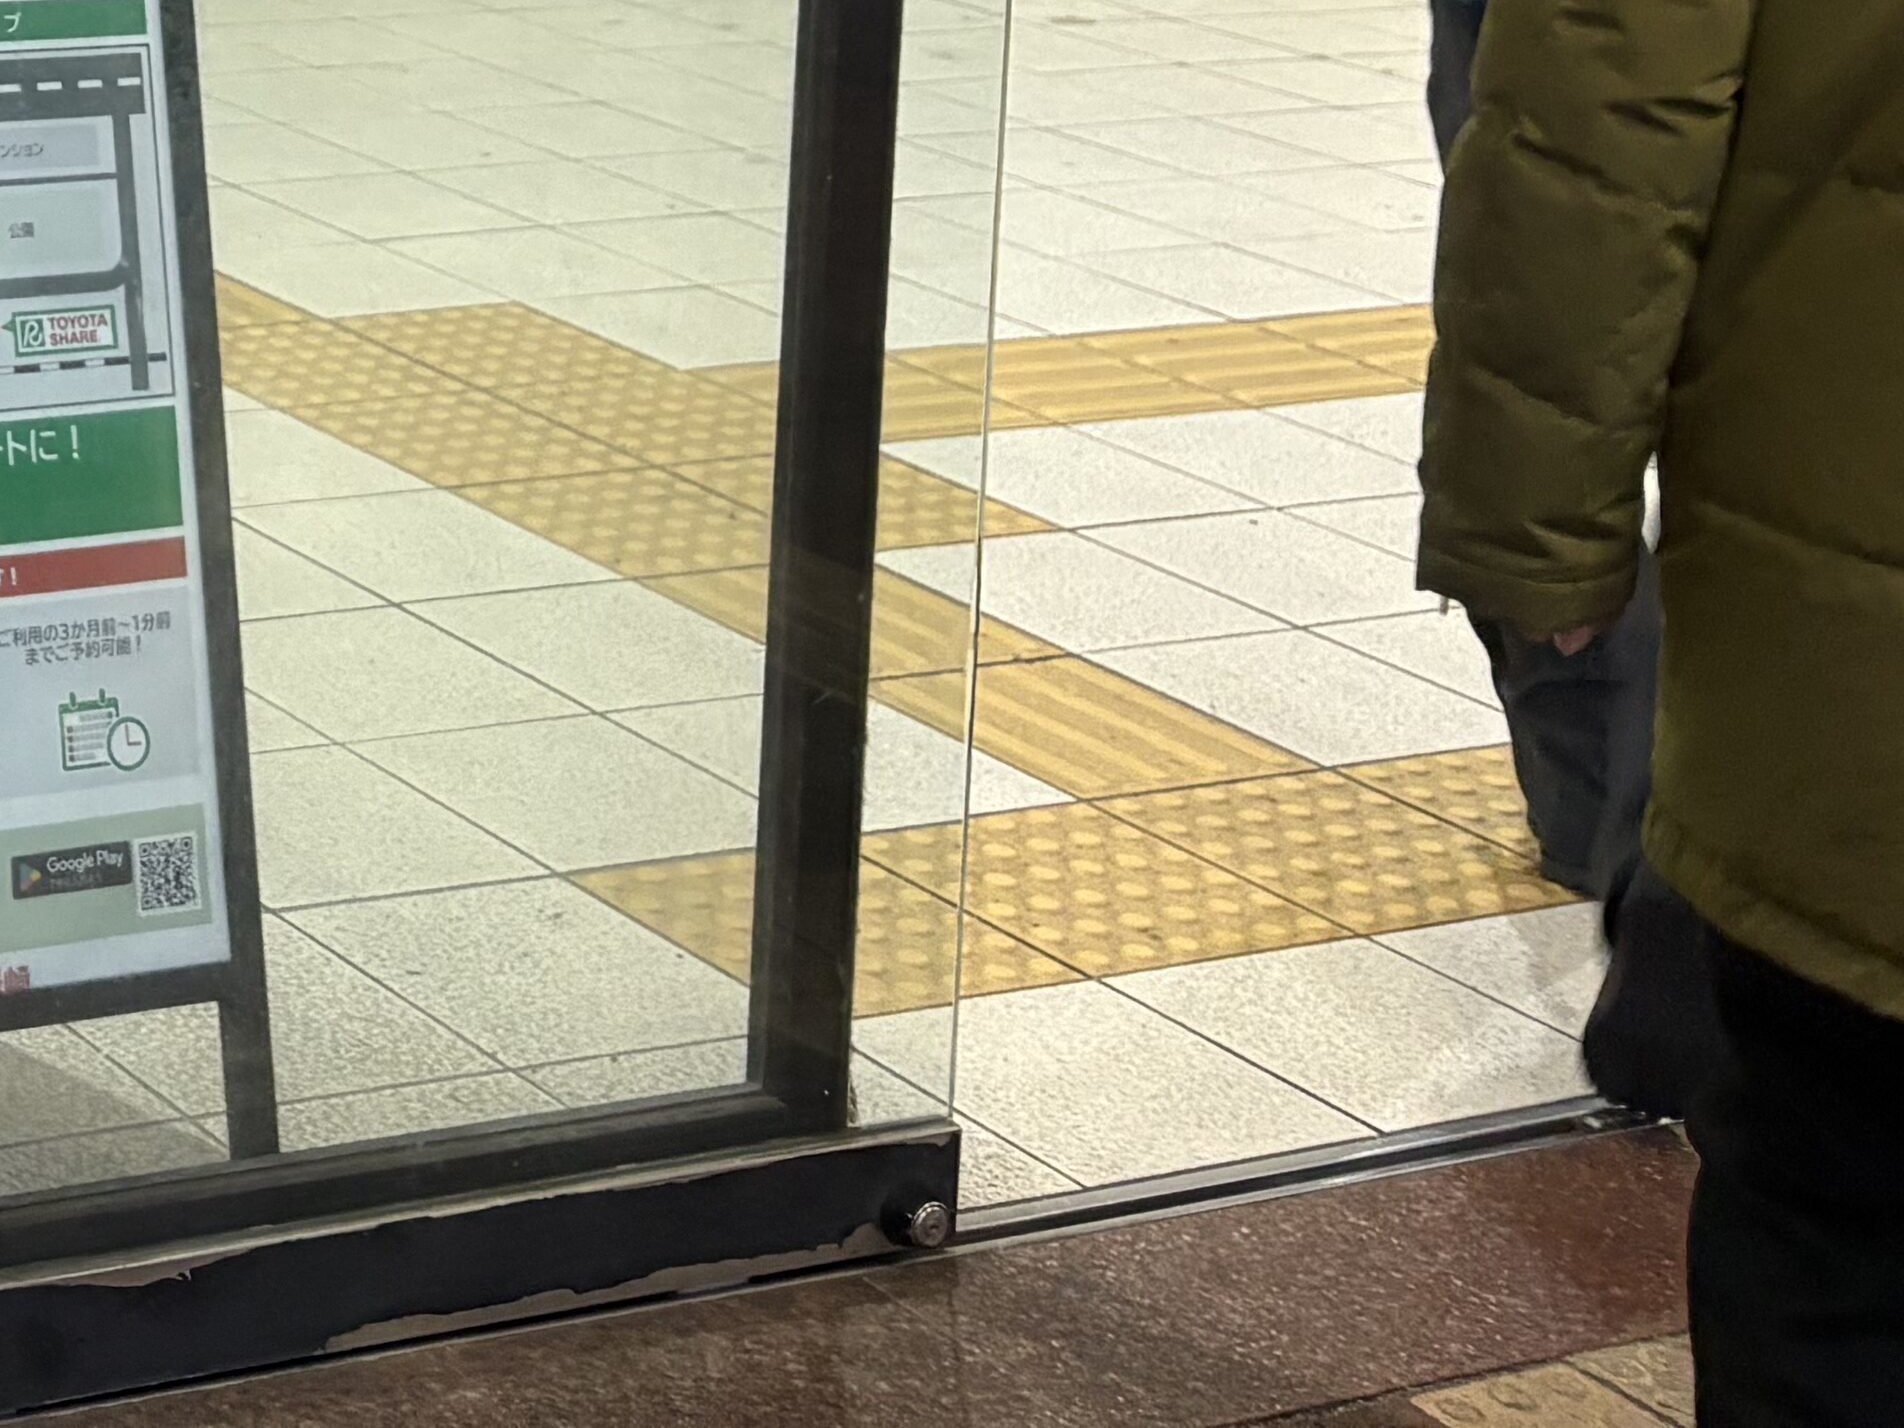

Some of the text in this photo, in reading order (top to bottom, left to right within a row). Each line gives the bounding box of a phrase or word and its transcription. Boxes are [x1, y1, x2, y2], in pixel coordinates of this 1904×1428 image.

[47, 312, 109, 331] TOYOTA
[49, 329, 99, 346] SHARE
[46, 849, 124, 873] Google Play
